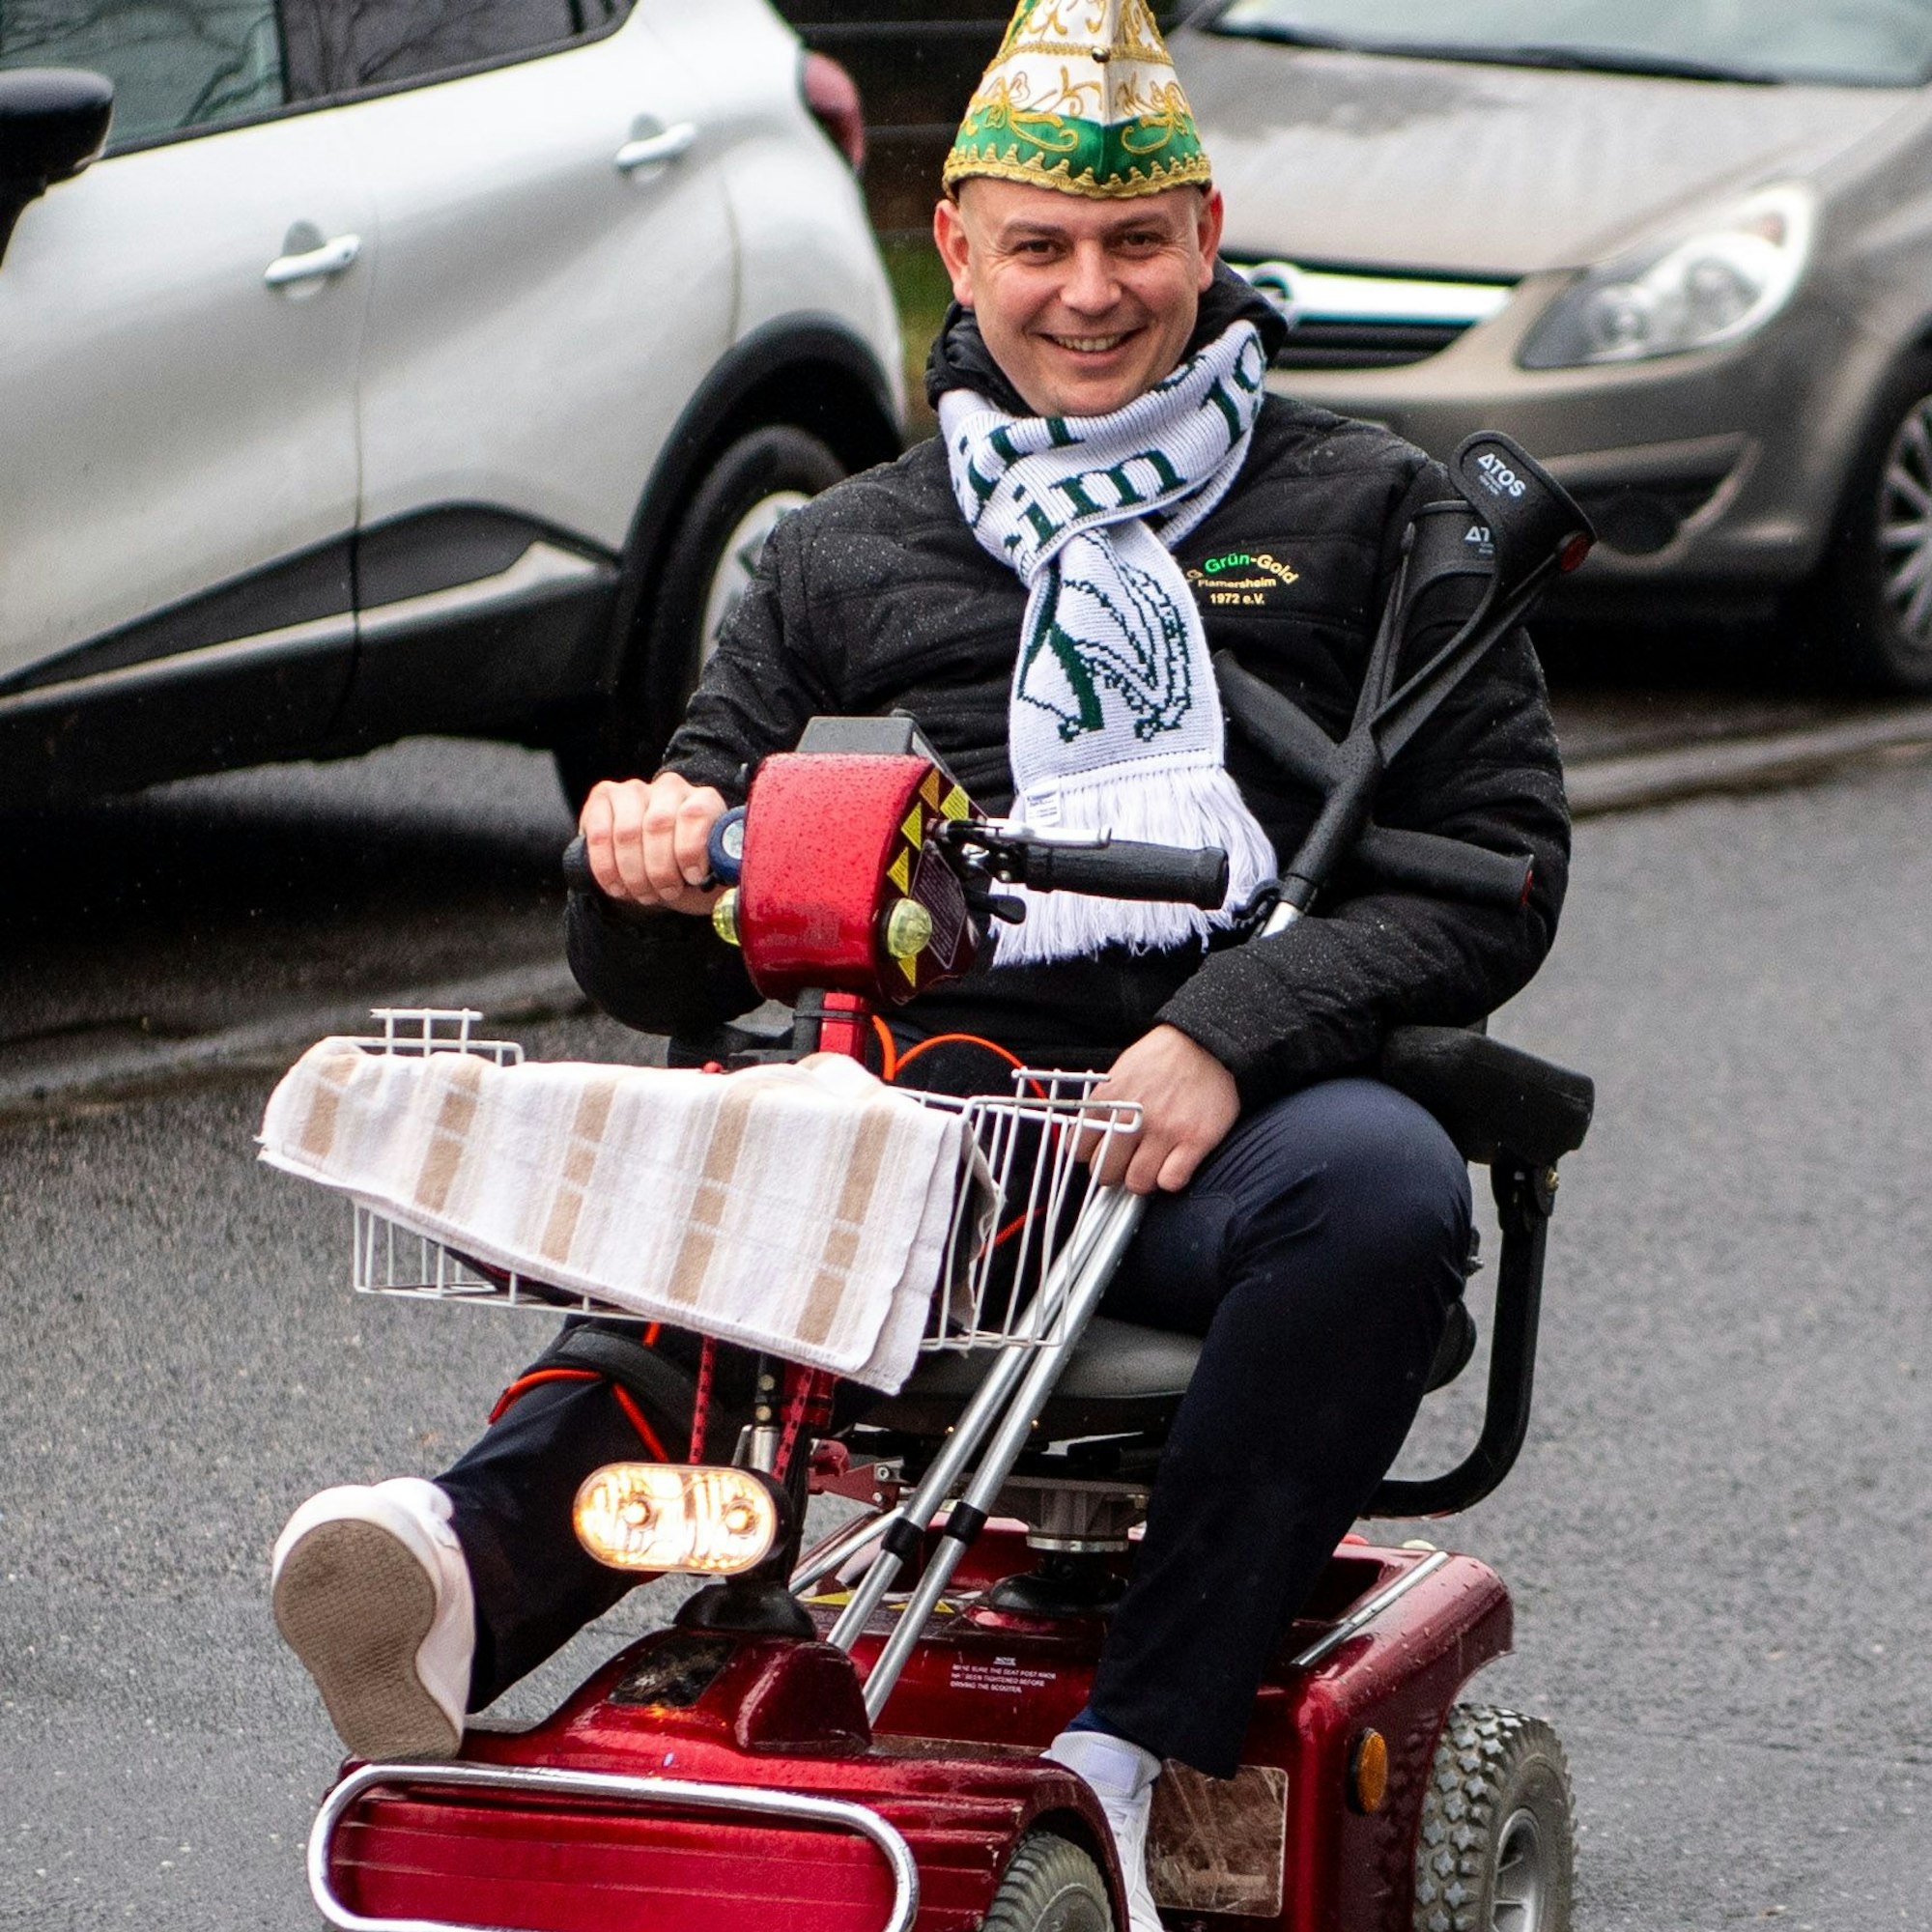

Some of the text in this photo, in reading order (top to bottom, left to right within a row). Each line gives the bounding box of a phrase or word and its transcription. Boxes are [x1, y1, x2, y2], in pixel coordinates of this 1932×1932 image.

[1477, 452, 1526, 497] ATOS
[1205, 553, 1299, 584] Grün-Gold
[1210, 592, 1265, 605] 1972 e.V.
